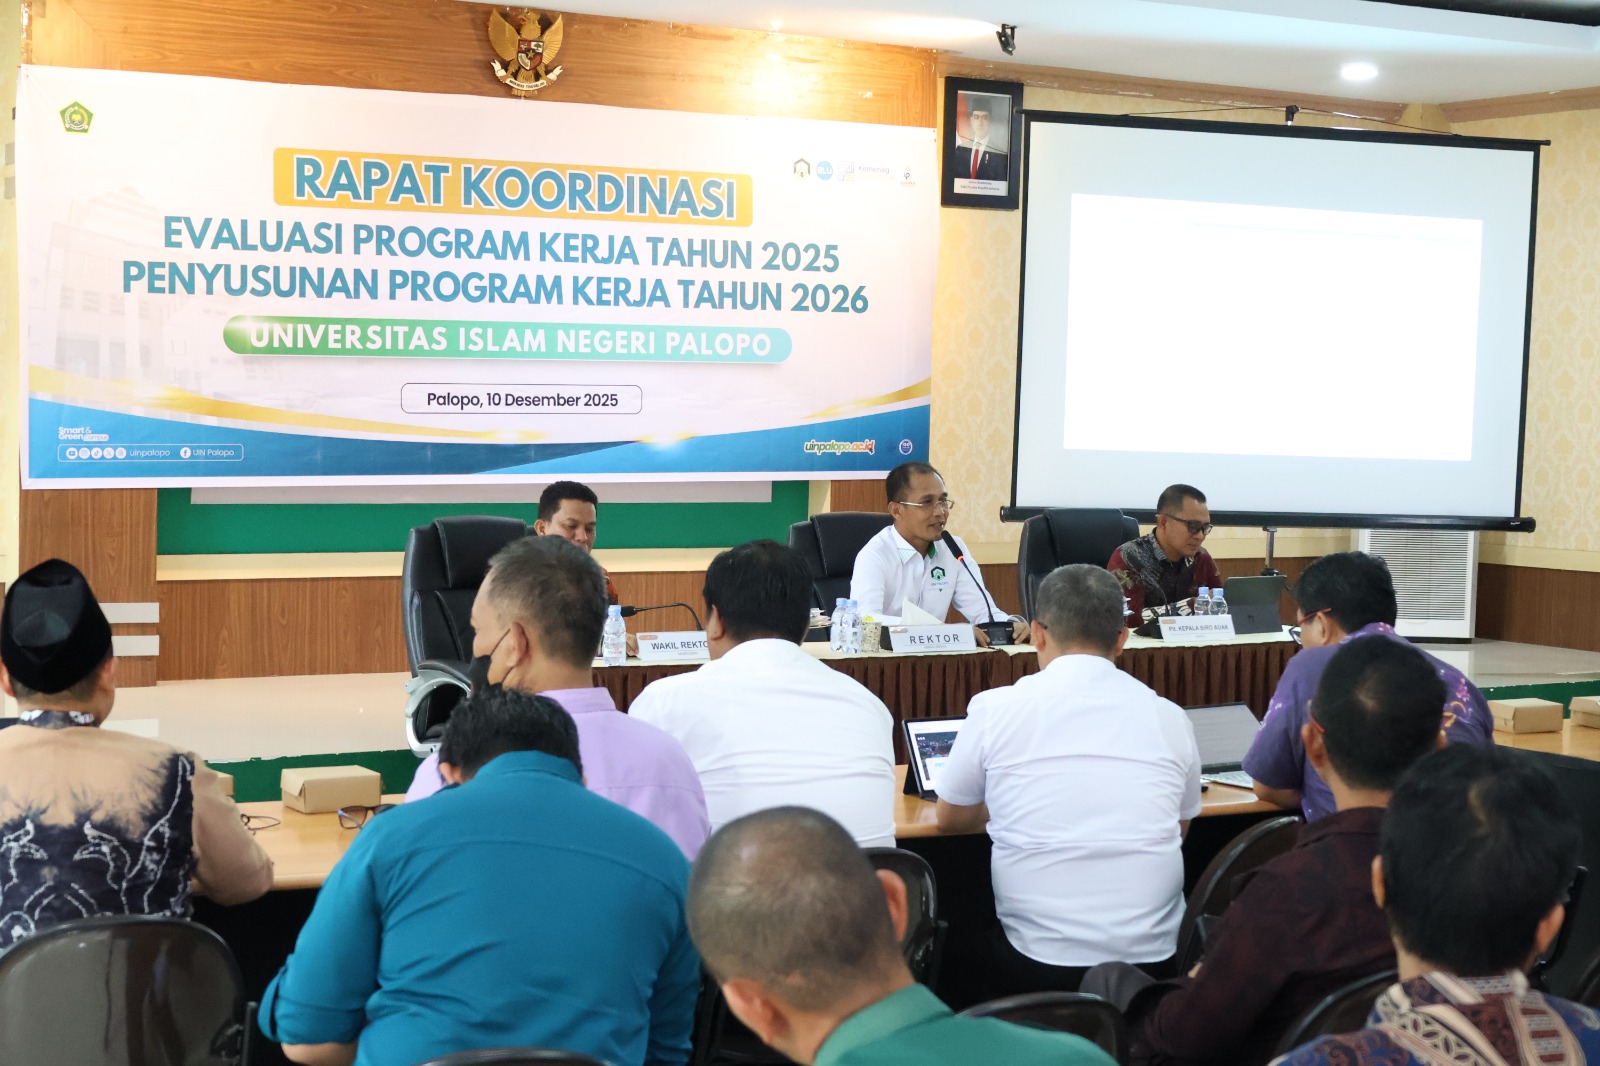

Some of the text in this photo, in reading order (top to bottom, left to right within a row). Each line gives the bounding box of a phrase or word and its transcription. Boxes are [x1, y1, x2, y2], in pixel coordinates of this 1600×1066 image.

[295, 156, 735, 218] RAPAT KOORDINASI
[165, 216, 840, 273] EVALUASI PROGRAM KERJA TAHUN 2025
[123, 261, 869, 314] PENYUSUNAN PROGRAM KERJA TAHUN 2026
[250, 323, 772, 357] UNIVERSITAS ISLAM NEGERI PALOPO
[427, 392, 619, 411] Palopo, 10 Desember 2025
[58, 426, 92, 434] Smart &
[58, 433, 84, 441] Green
[129, 448, 171, 458] uinpalopo
[192, 448, 236, 458] UIN Palopo
[804, 440, 875, 455] uinpalopo.ac.id
[651, 640, 708, 650] WAKIL REKTO
[909, 633, 960, 644] REKTOR
